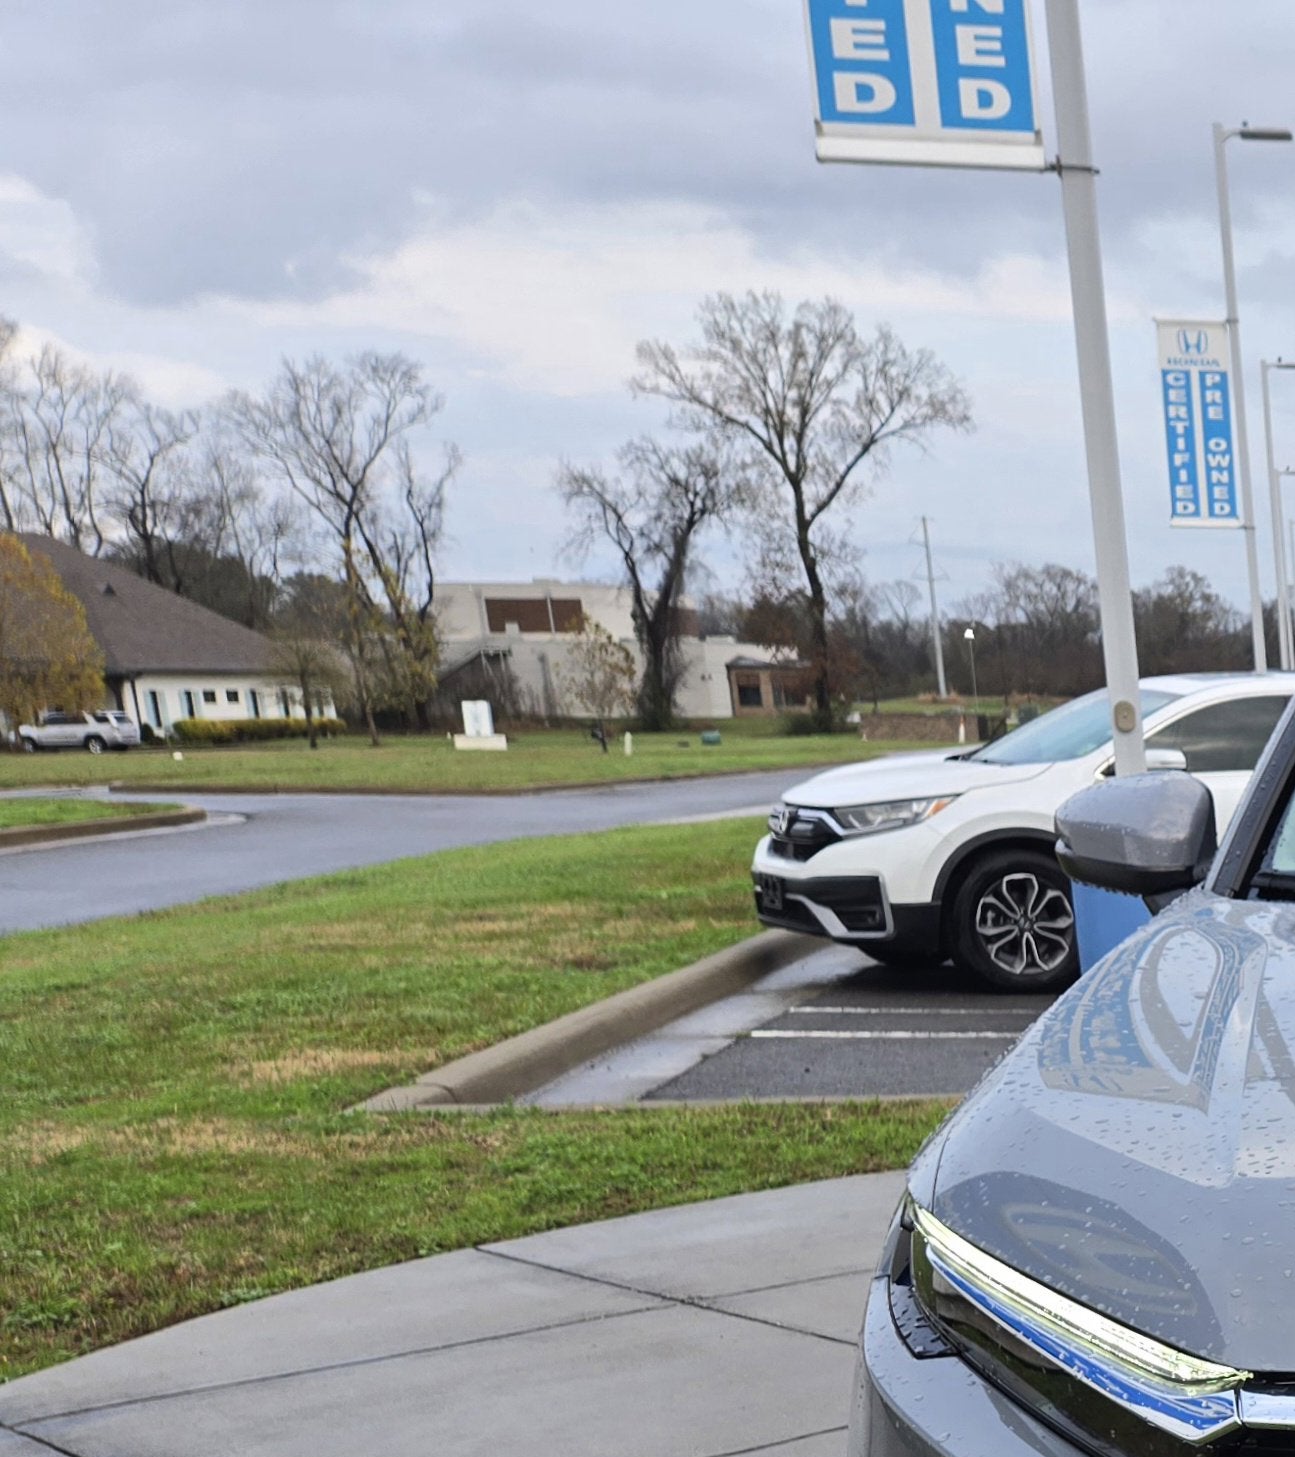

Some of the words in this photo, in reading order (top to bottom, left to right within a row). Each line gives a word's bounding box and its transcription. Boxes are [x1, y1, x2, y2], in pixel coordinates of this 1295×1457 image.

[829, 0, 898, 115] ED
[1165, 372, 1196, 516] CERTIFIED
[1204, 373, 1225, 421] PRE
[1206, 437, 1231, 516] OWNED
